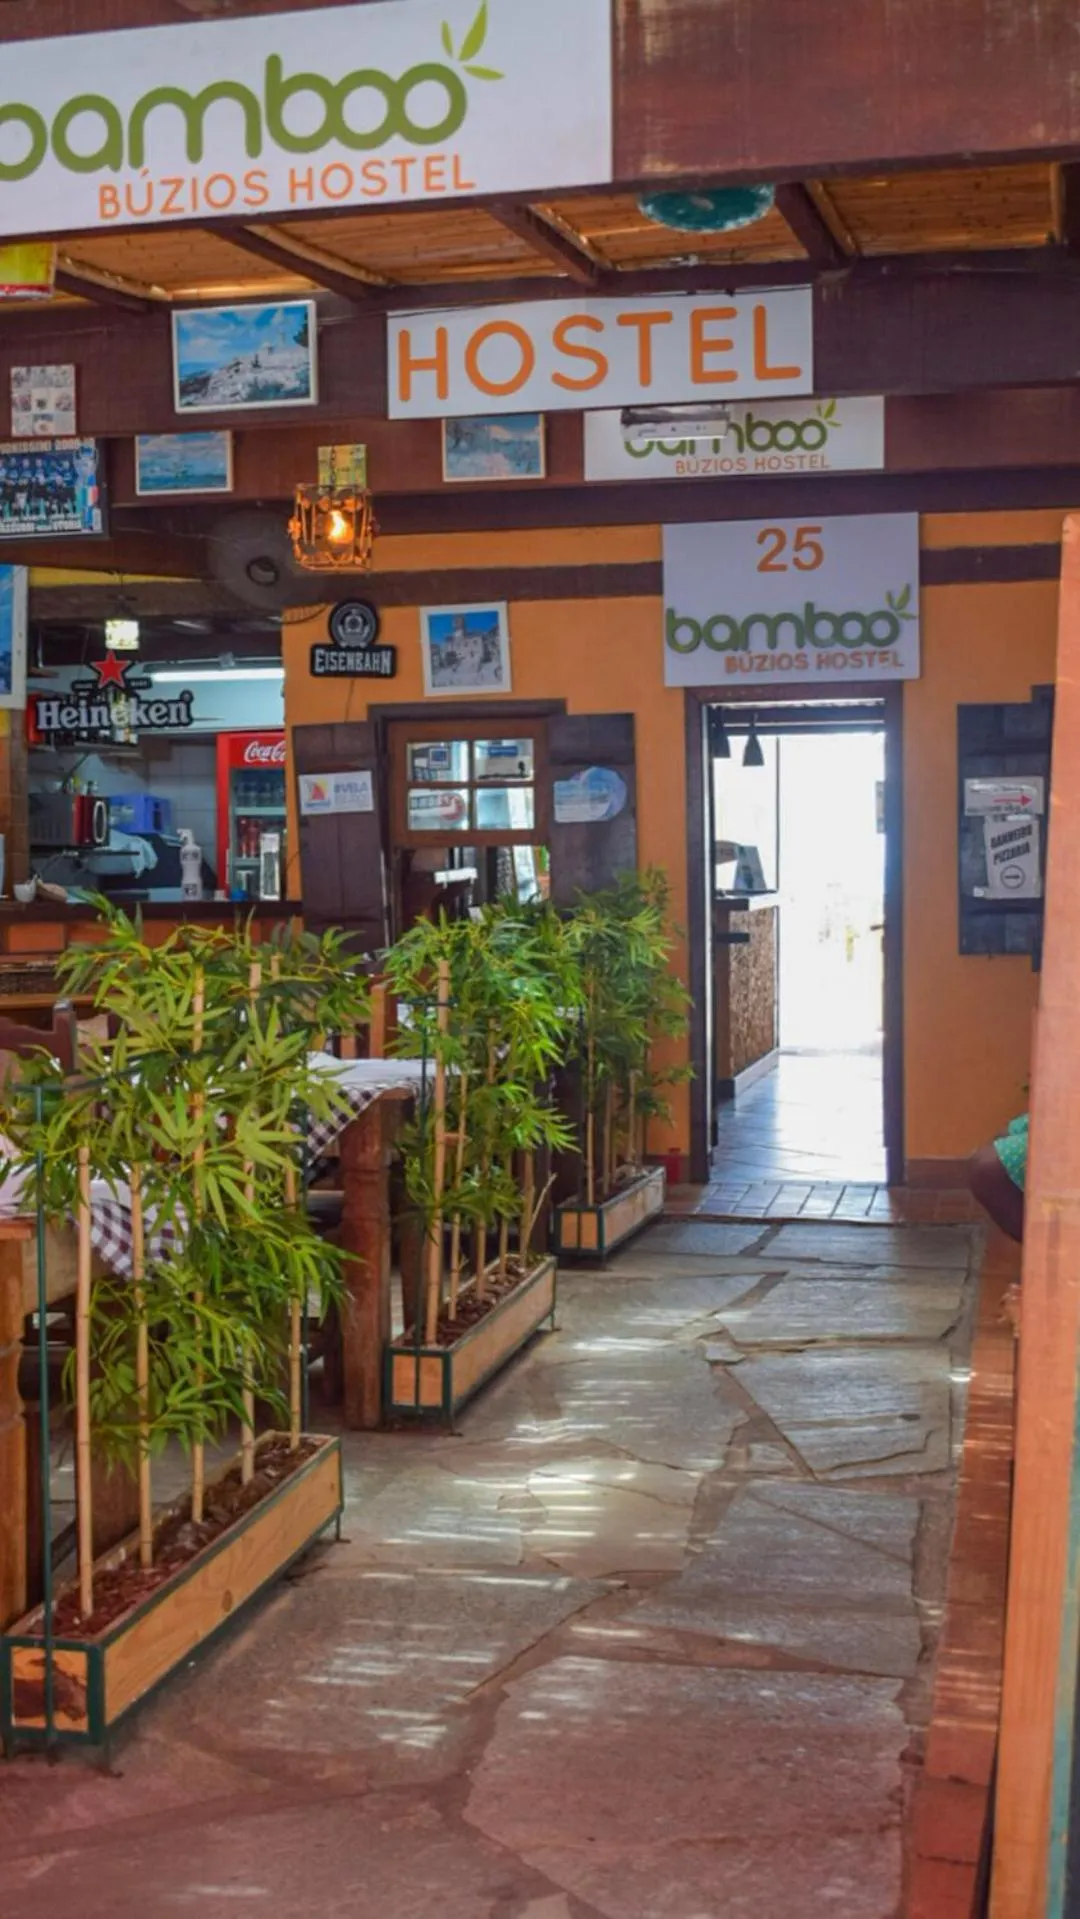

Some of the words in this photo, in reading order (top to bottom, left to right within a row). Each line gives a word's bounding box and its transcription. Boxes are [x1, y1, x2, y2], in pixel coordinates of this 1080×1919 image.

[98, 168, 269, 219] BÚZIOS
[288, 154, 475, 203] HOSTEL
[399, 305, 803, 402] HOSTEL
[754, 454, 829, 470] HOSTEL
[757, 526, 823, 573] 25
[666, 602, 900, 654] bamboo
[315, 648, 392, 674] EISENBAHN
[816, 649, 904, 670] HOSTEL
[37, 695, 190, 730] Heineken
